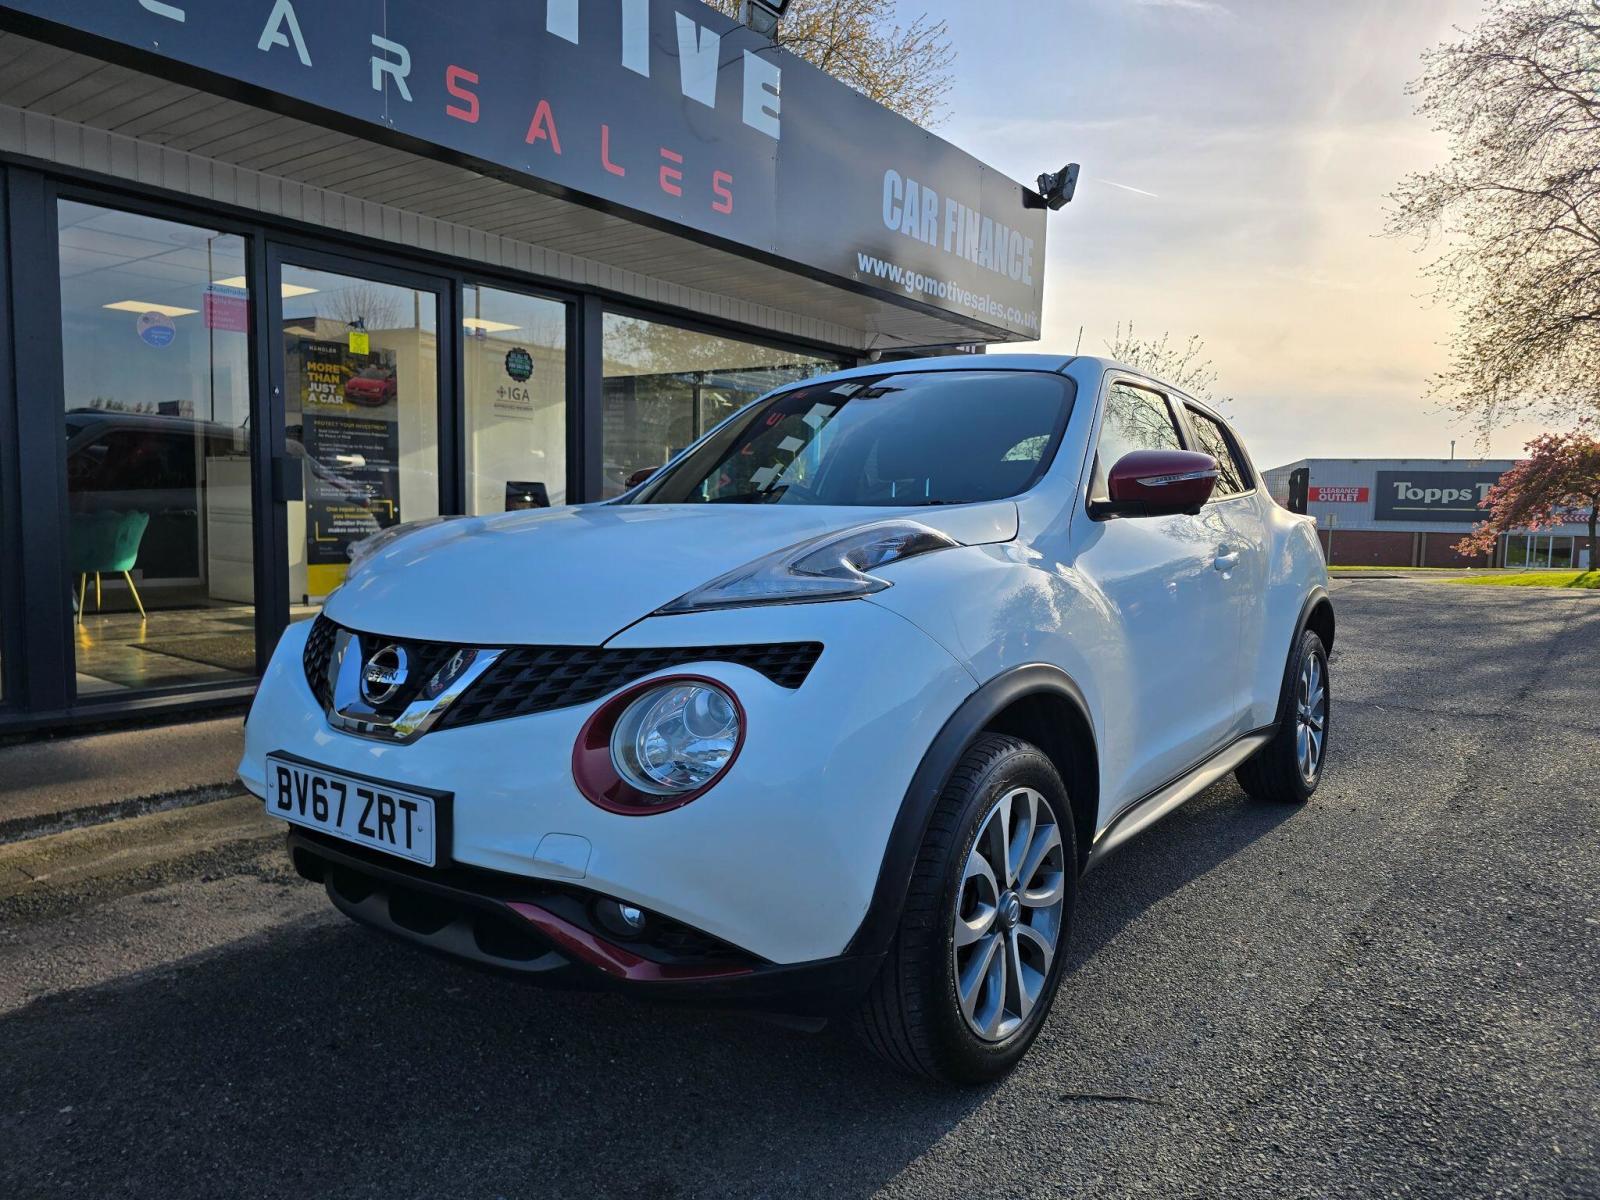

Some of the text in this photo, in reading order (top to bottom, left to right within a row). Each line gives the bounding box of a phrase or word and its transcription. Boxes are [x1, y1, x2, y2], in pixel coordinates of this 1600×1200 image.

[139, 0, 733, 214] AR SALES
[882, 169, 1034, 287] CAR FINANCE
[858, 252, 1038, 330] www.gomotivesales.co.uk
[307, 361, 340, 374] MORE
[307, 372, 340, 383] THAN
[308, 382, 337, 394] JUST
[508, 386, 530, 401] IGA
[308, 392, 344, 405] A CAR
[1319, 493, 1359, 502] OUTLET
[1393, 481, 1473, 504] Topps
[277, 766, 418, 850] BV67 ZRT
